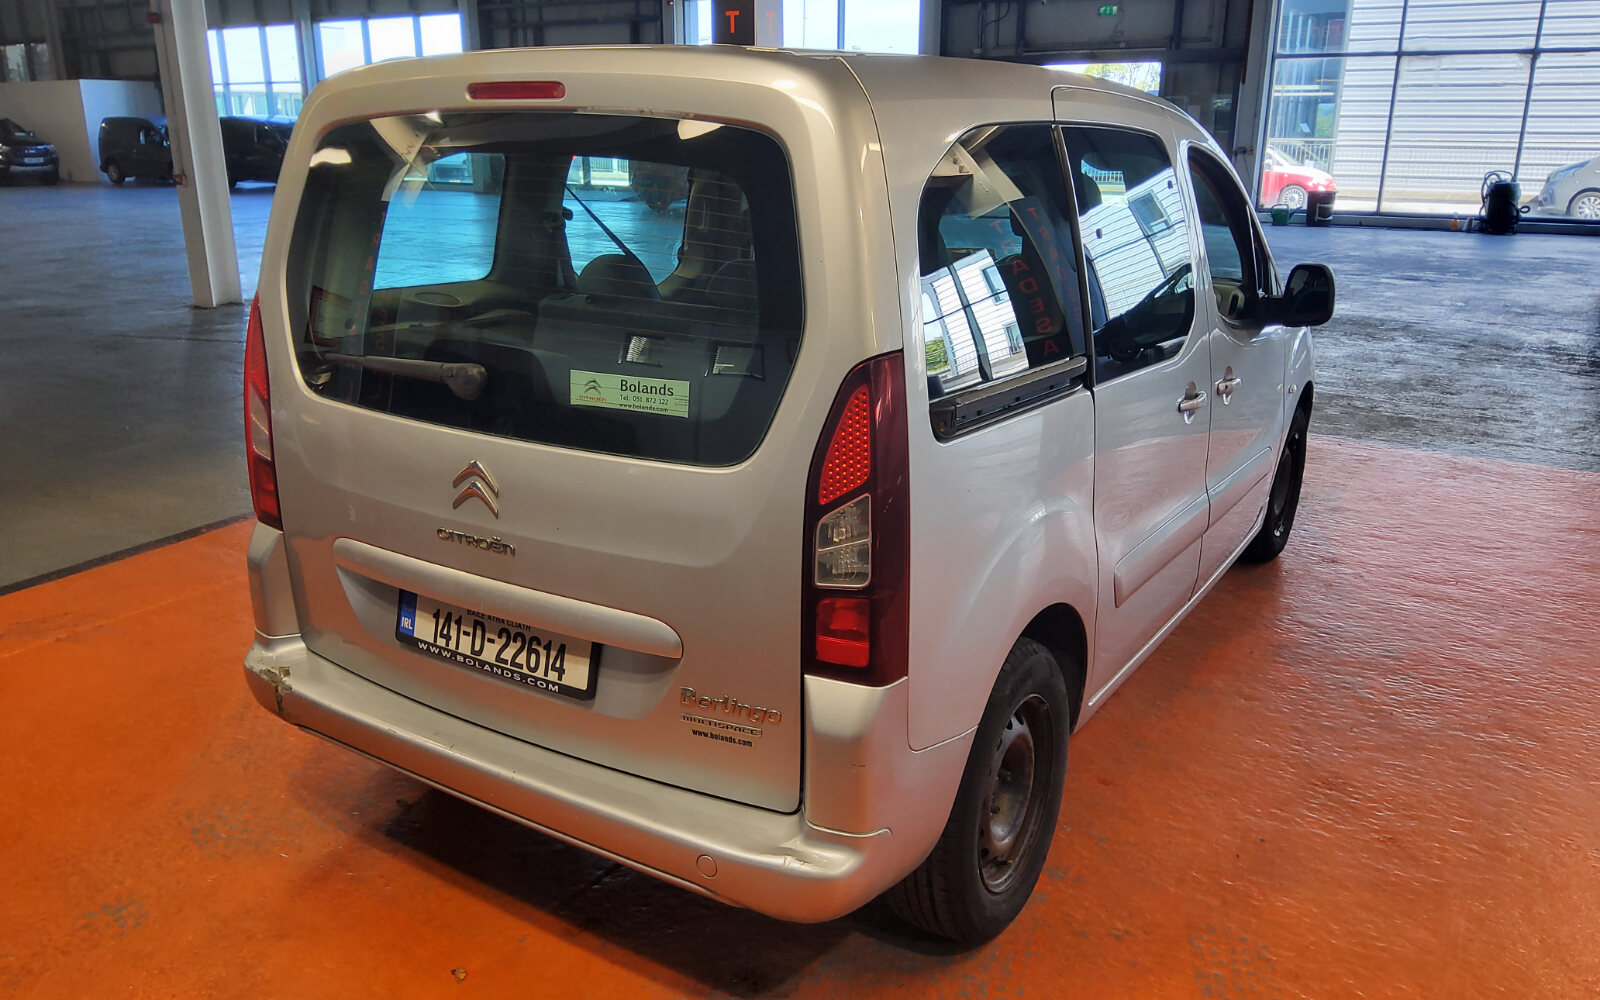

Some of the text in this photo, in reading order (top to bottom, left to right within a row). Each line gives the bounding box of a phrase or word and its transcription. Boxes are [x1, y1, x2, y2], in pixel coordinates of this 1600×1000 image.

[725, 10, 740, 34] T
[620, 379, 674, 397] Bolands
[619, 403, 669, 413] www.bolands.com
[633, 395, 643, 403] 051
[401, 616, 413, 631] IRL
[432, 608, 567, 682] 141-D-22614
[418, 641, 559, 693] WWW.BOLANDS.COM
[679, 686, 782, 725] Berlingo
[691, 728, 753, 748] www.bolands.com
